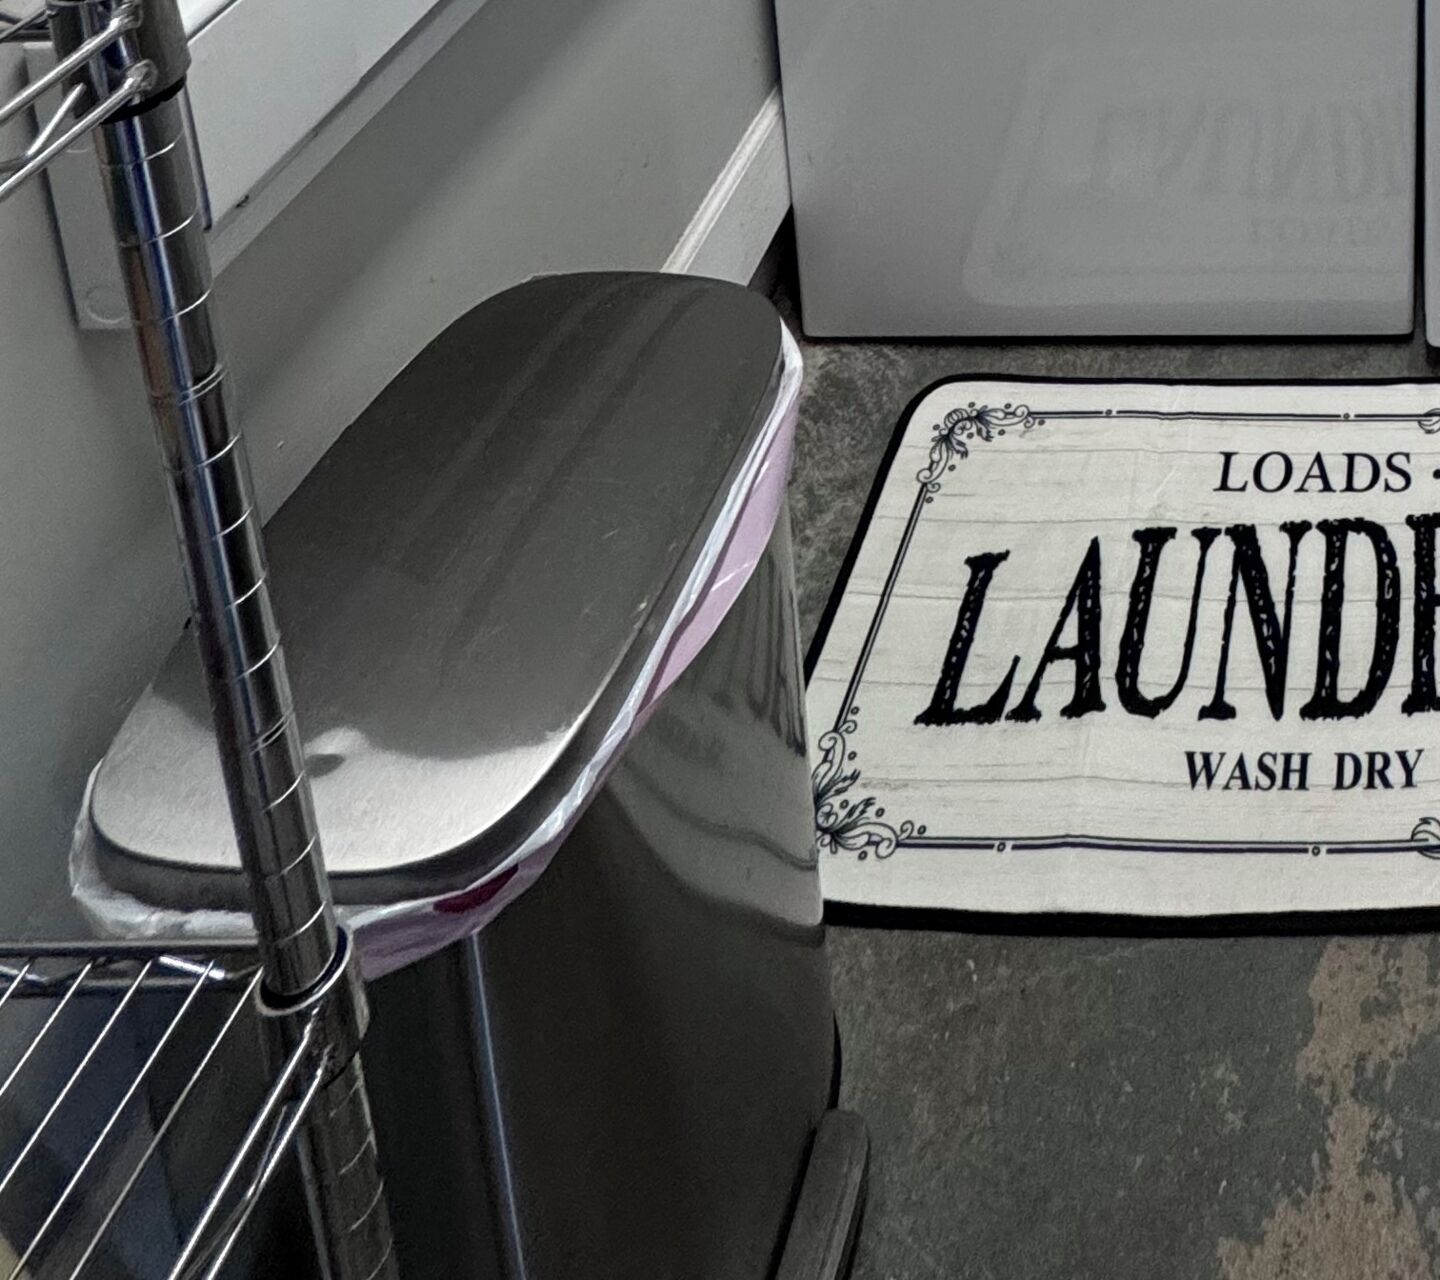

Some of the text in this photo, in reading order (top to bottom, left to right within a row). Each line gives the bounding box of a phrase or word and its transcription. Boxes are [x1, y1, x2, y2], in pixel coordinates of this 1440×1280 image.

[1213, 451, 1412, 493] LOADS
[1185, 751, 1311, 792] WASH
[1333, 748, 1424, 792] DRY
